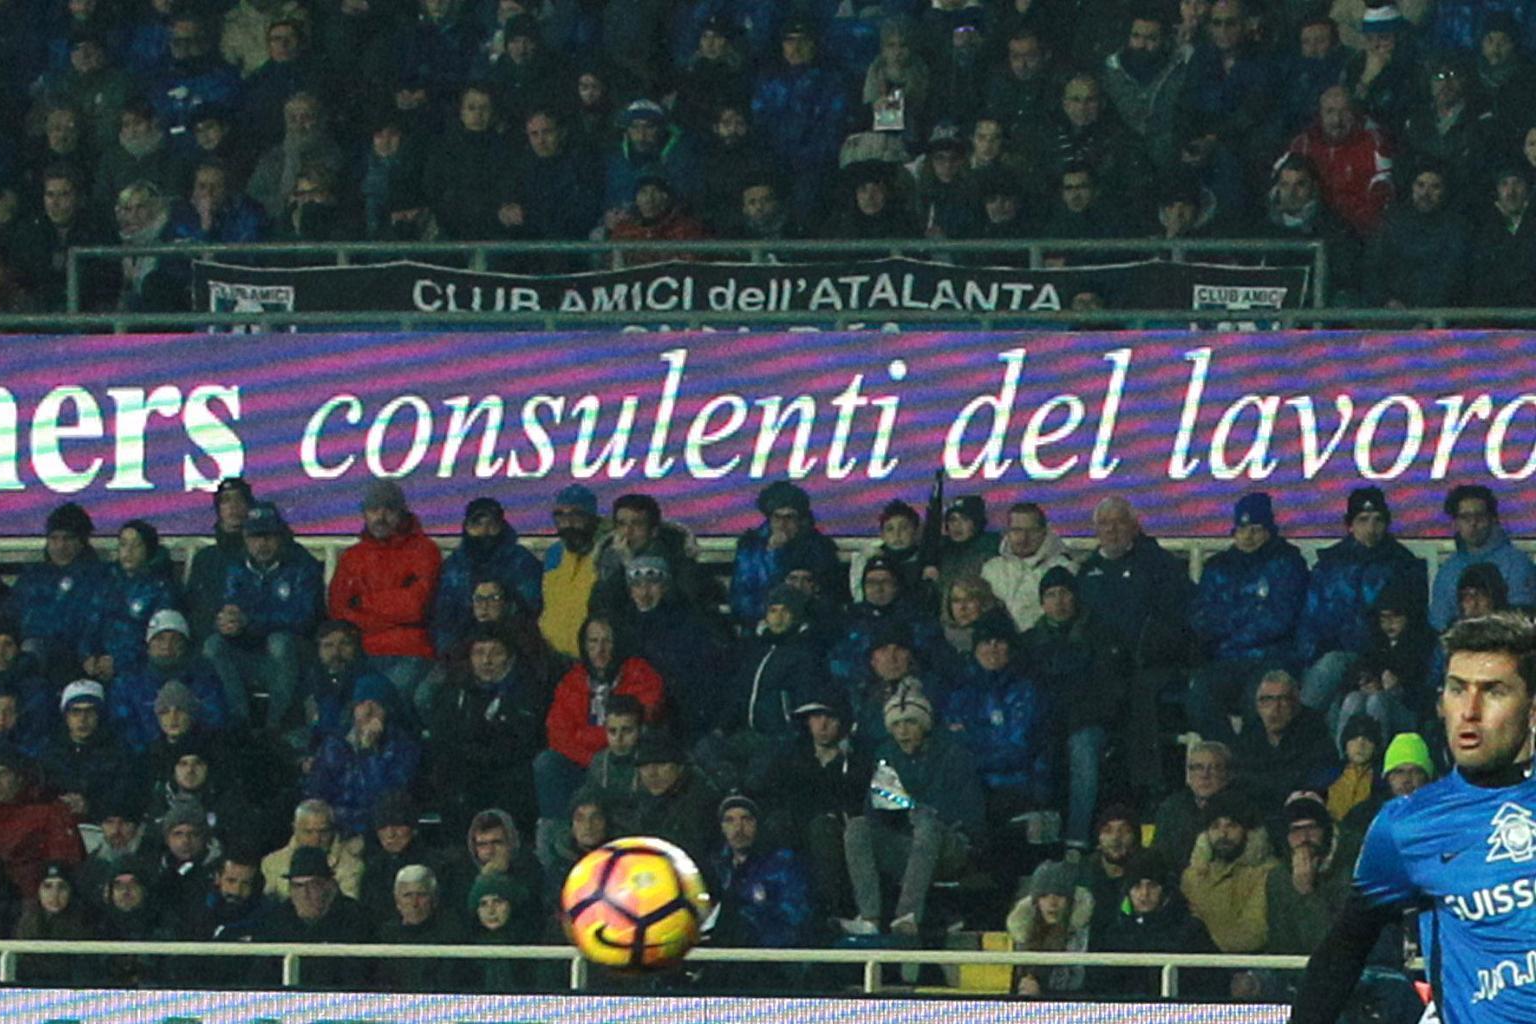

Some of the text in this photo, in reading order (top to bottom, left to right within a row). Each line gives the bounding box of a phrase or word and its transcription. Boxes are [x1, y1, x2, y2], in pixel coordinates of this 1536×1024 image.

[560, 275, 694, 313] AMICI
[708, 272, 1062, 312] dell'ATALANTA
[300, 348, 907, 479] consulenti
[943, 348, 1131, 481] del
[1168, 347, 1536, 482] lavoro
